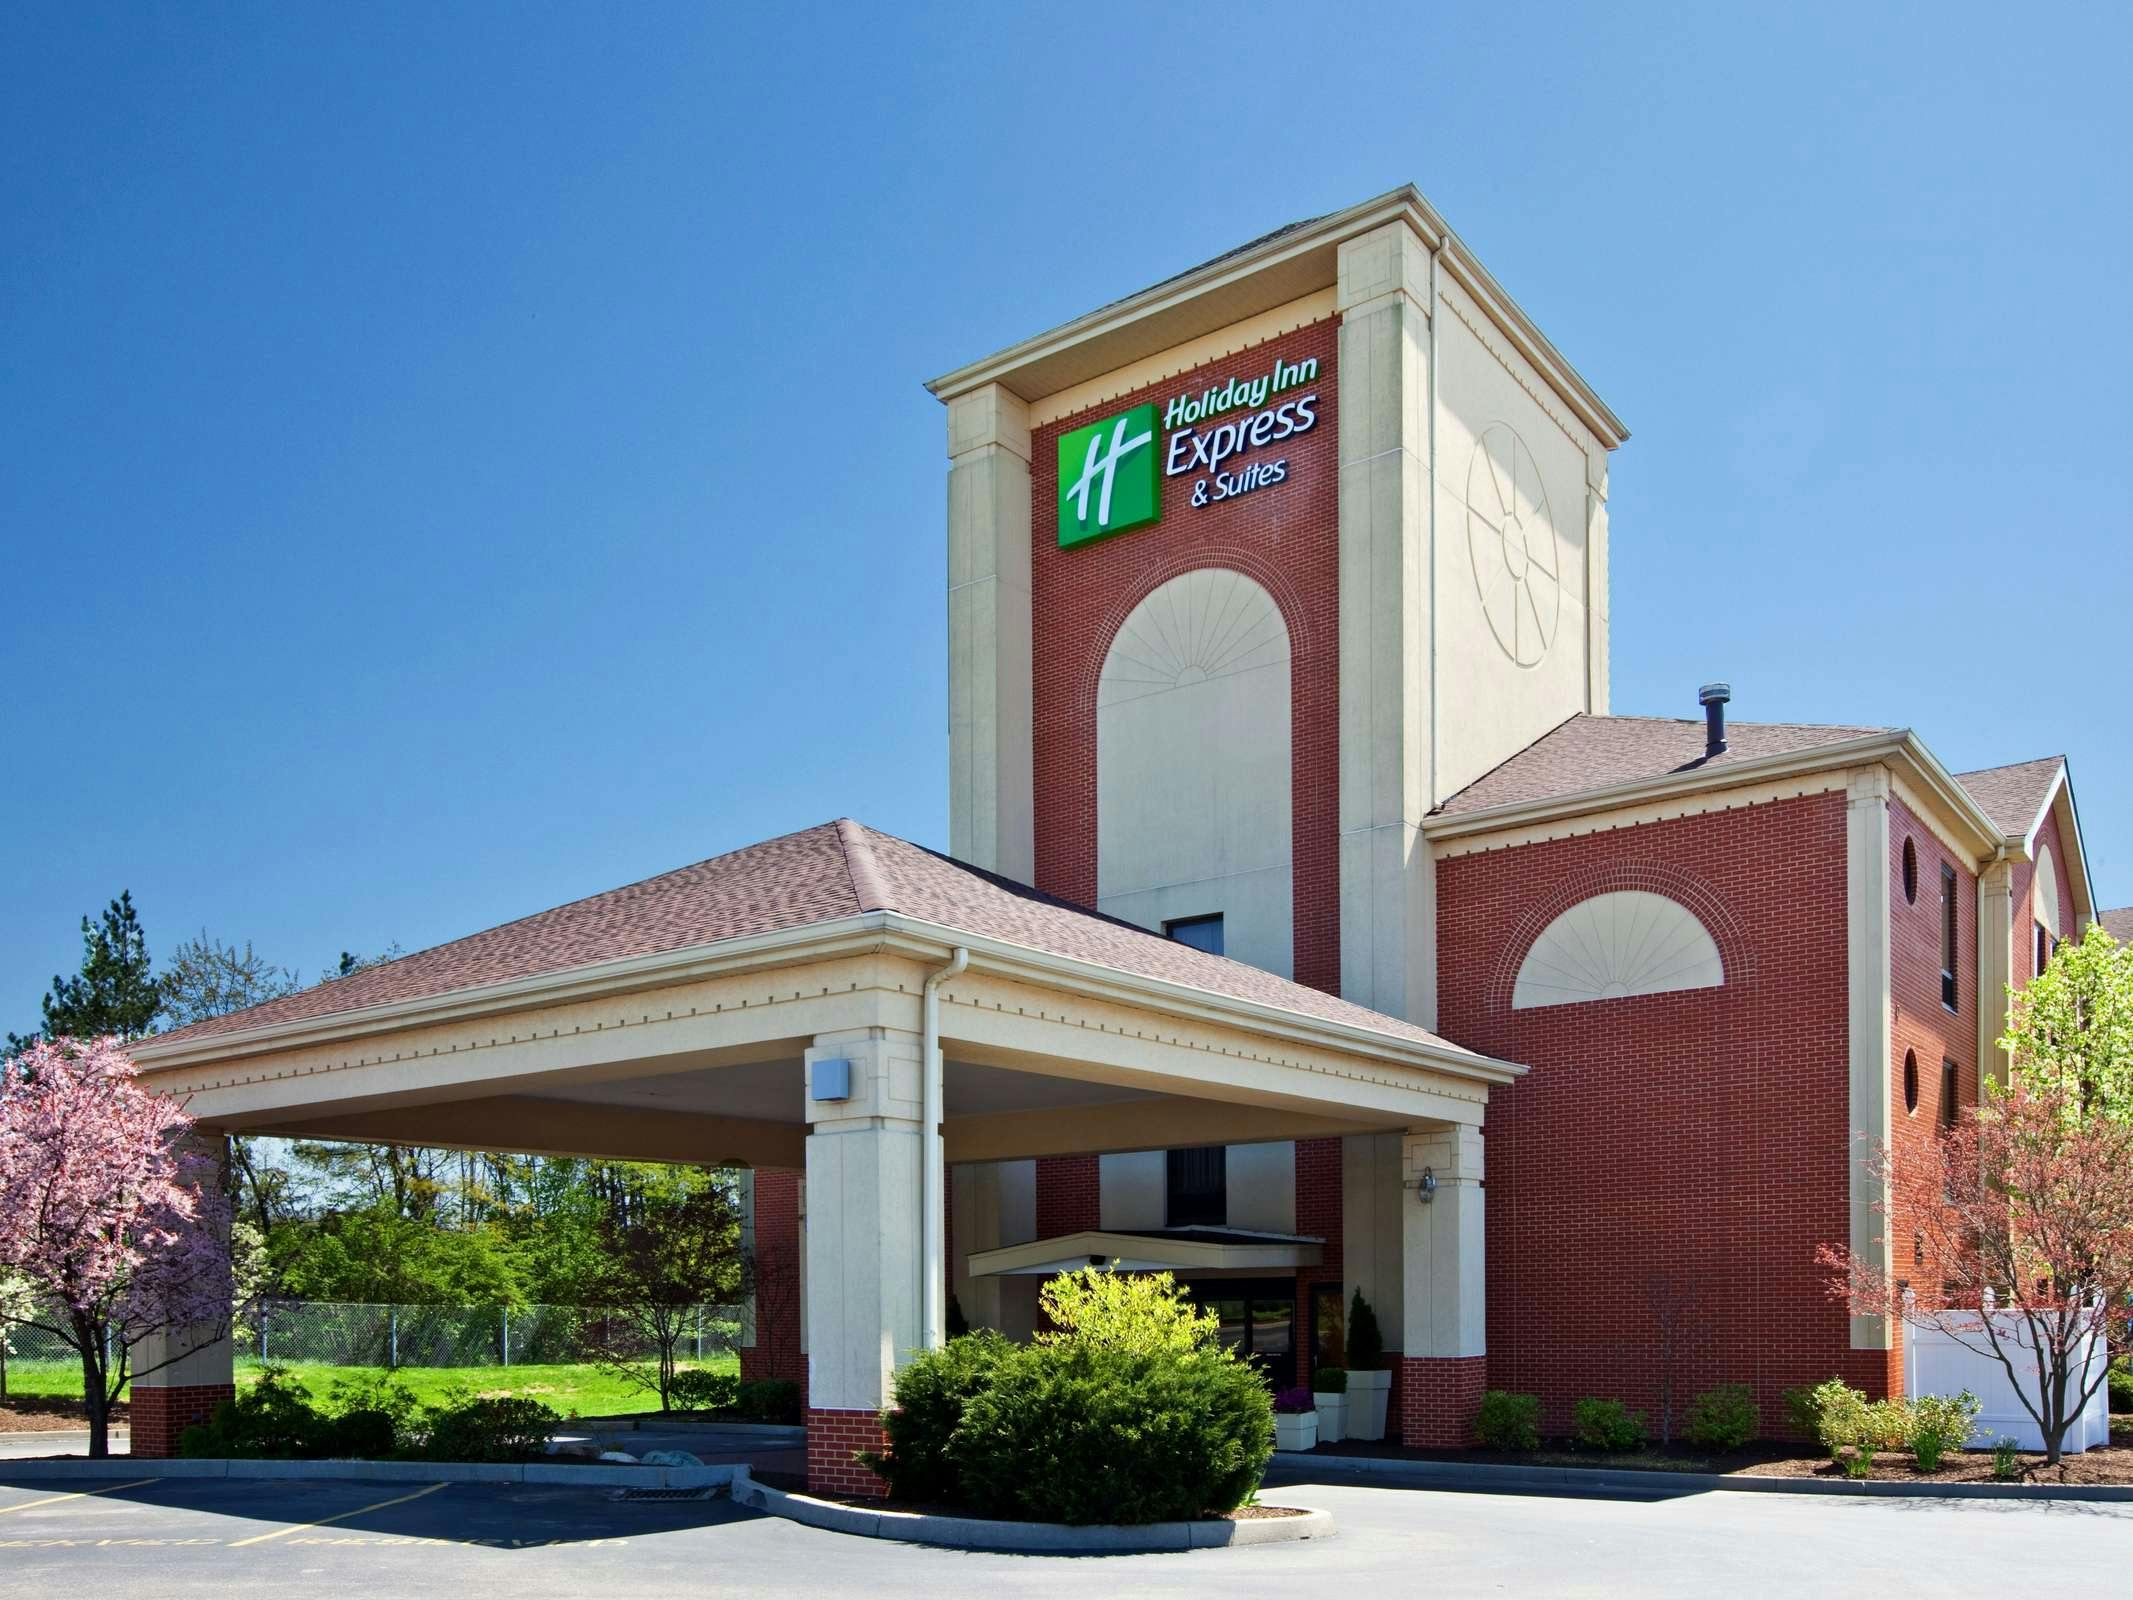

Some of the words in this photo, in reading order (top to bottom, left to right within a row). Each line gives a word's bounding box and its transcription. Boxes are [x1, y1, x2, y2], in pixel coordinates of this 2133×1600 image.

[1164, 377, 1269, 430] Holiday
[1272, 357, 1318, 392] Inn
[1166, 395, 1317, 476] Express
[1190, 479, 1209, 507] &
[1212, 459, 1287, 501] Suites
